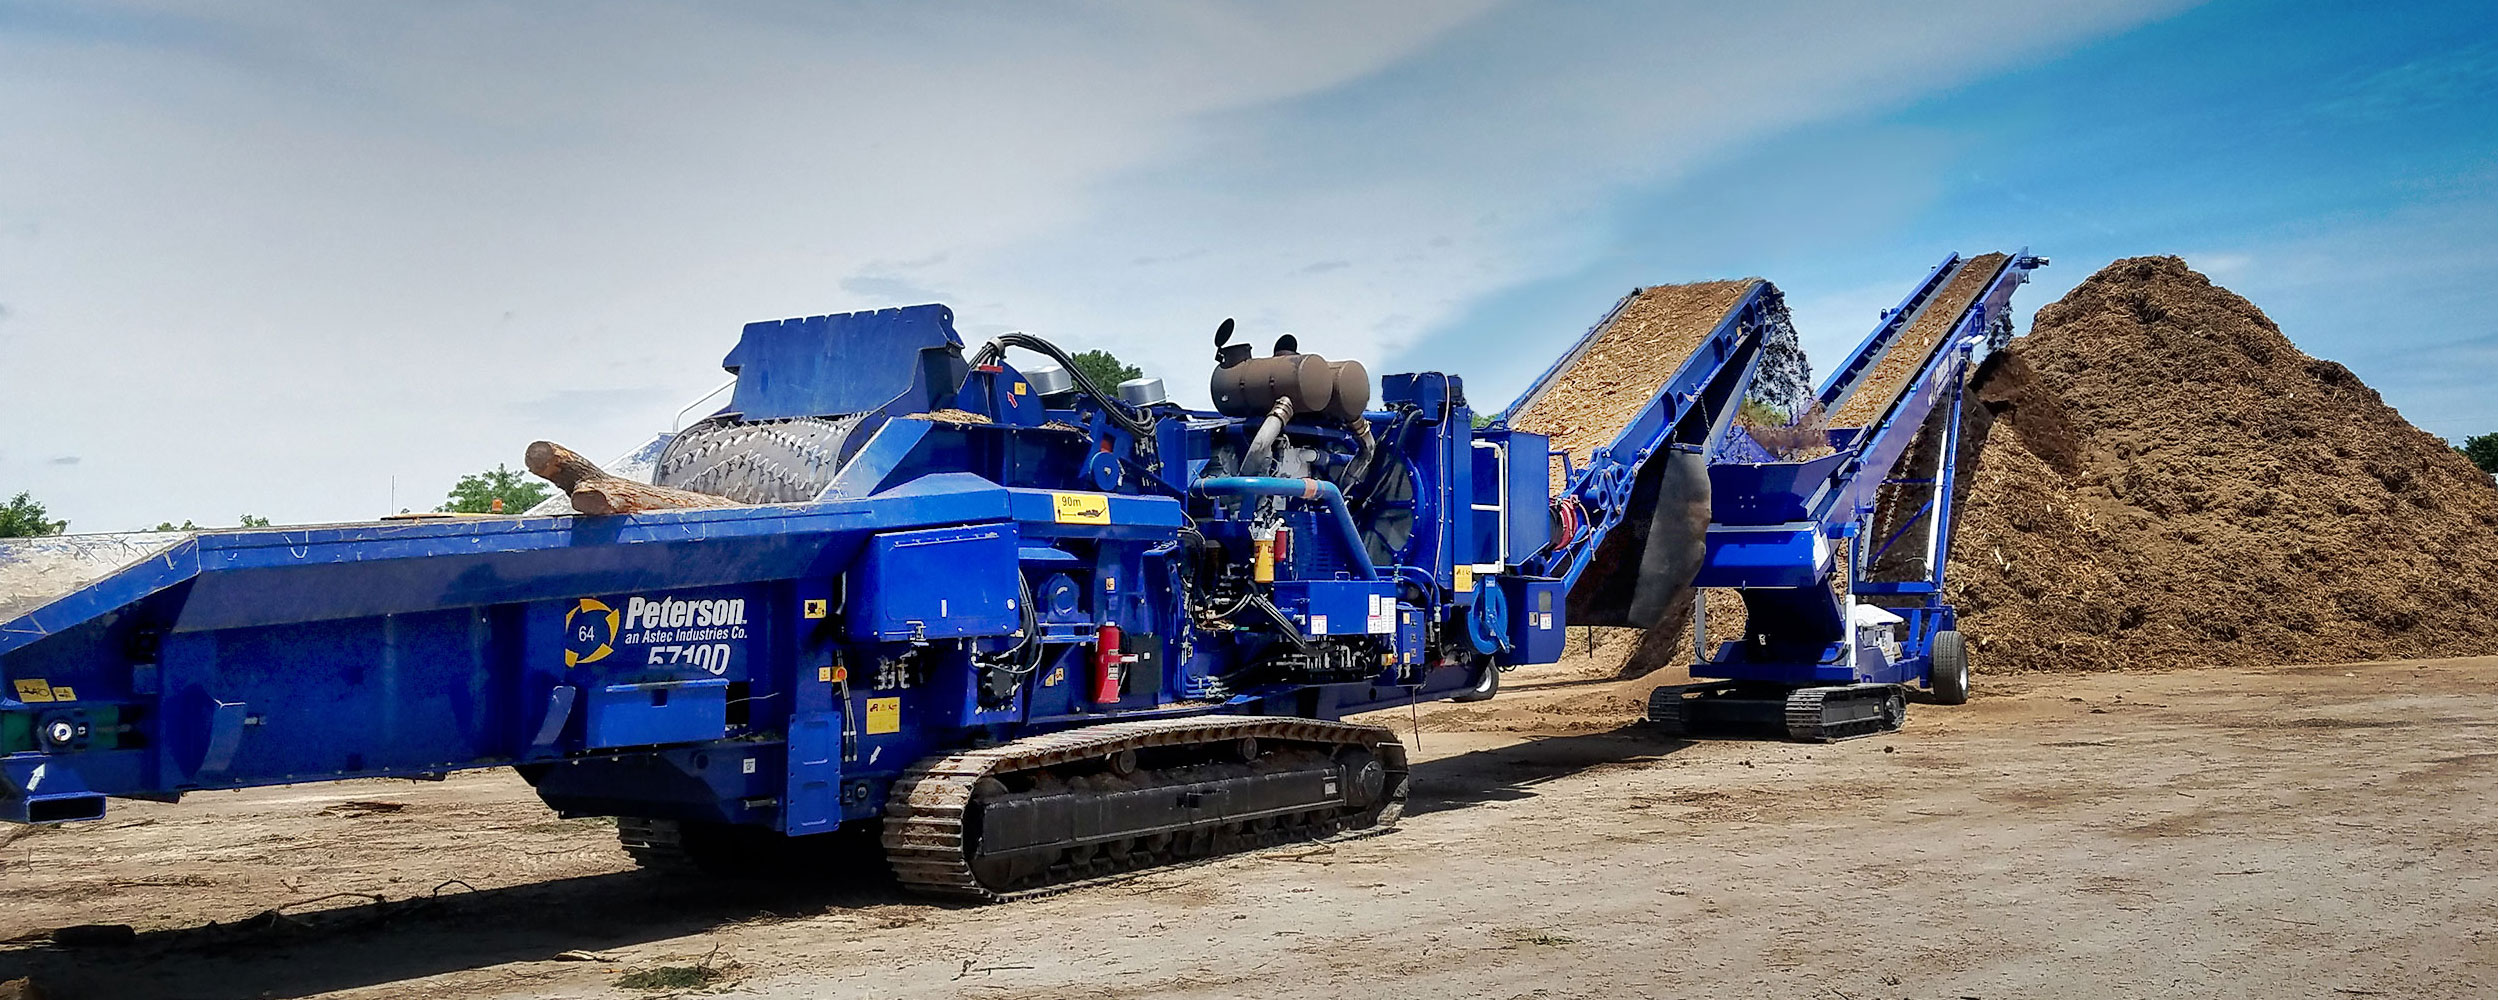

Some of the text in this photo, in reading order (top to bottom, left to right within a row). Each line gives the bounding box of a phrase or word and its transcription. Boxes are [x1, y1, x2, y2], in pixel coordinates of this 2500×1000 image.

[1061, 496, 1081, 506] 90m
[625, 596, 745, 629] Peterson
[578, 626, 595, 642] 64
[625, 626, 748, 644] an Astec Industries Co.
[647, 643, 731, 675] 5710D
